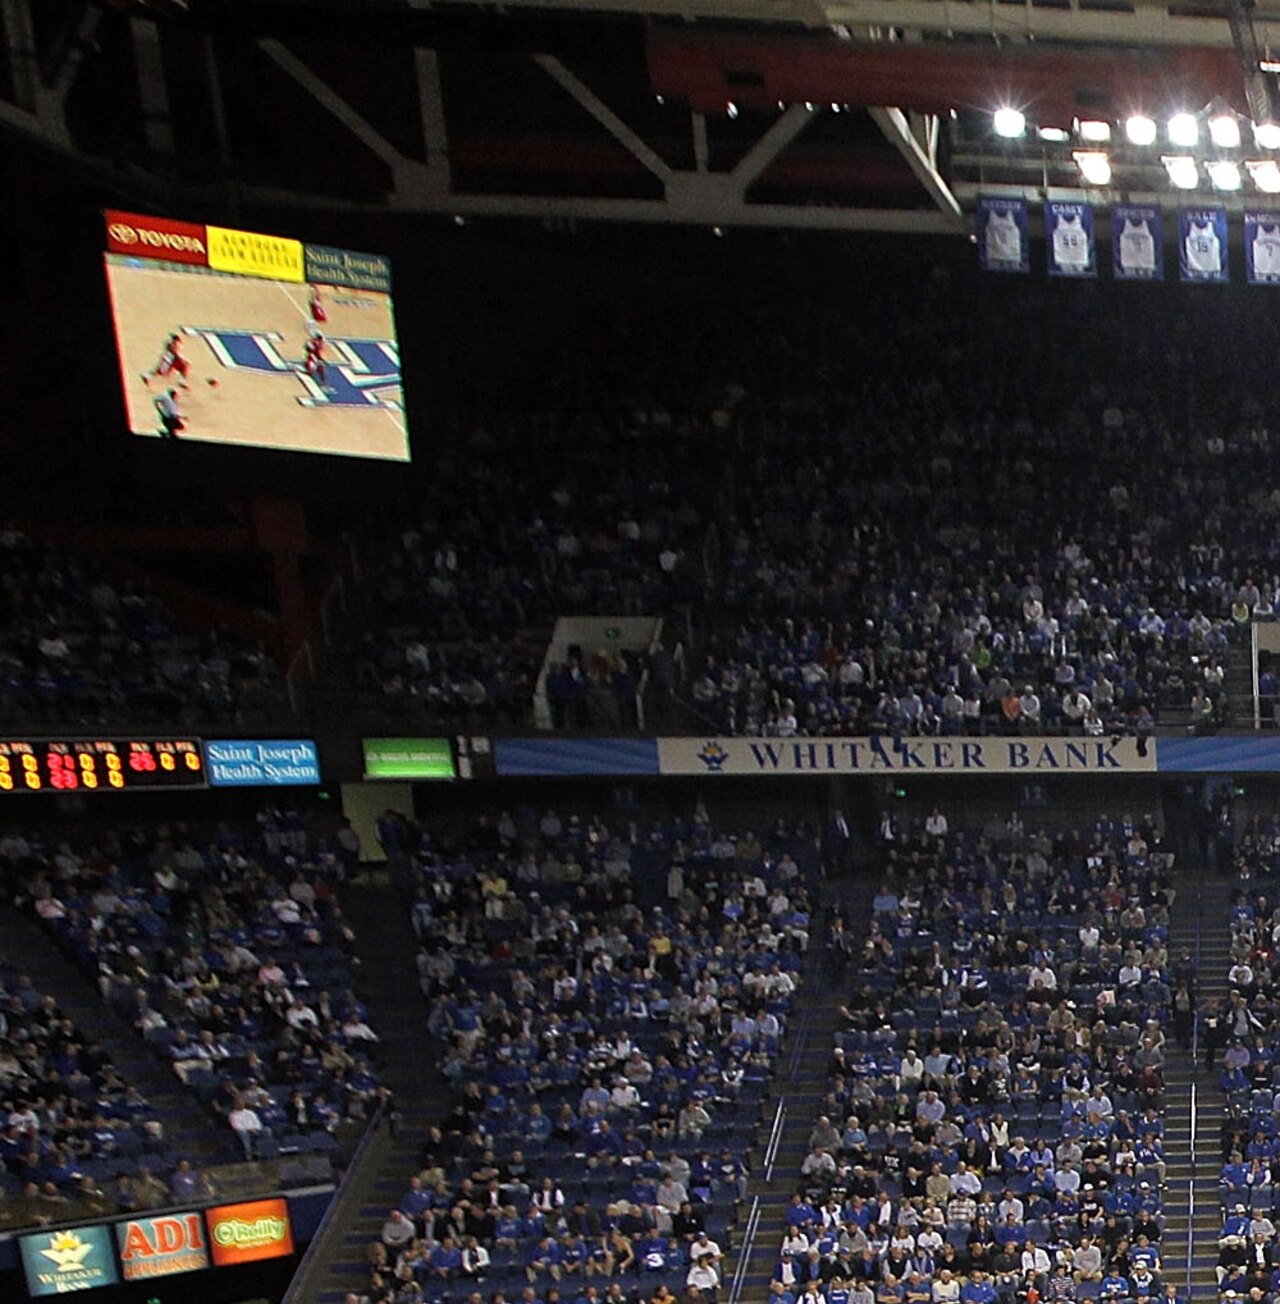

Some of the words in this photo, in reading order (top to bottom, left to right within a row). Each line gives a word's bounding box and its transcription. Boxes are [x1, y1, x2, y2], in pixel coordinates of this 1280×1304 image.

[137, 228, 205, 254] TOYOTA
[343, 254, 387, 274] Joseph
[209, 745, 252, 761] Saint
[257, 745, 313, 765] Joseph
[749, 742, 986, 768] WHITAKER
[1008, 742, 1122, 768] BANK
[213, 764, 262, 779] Health
[121, 1214, 205, 1260] ADI
